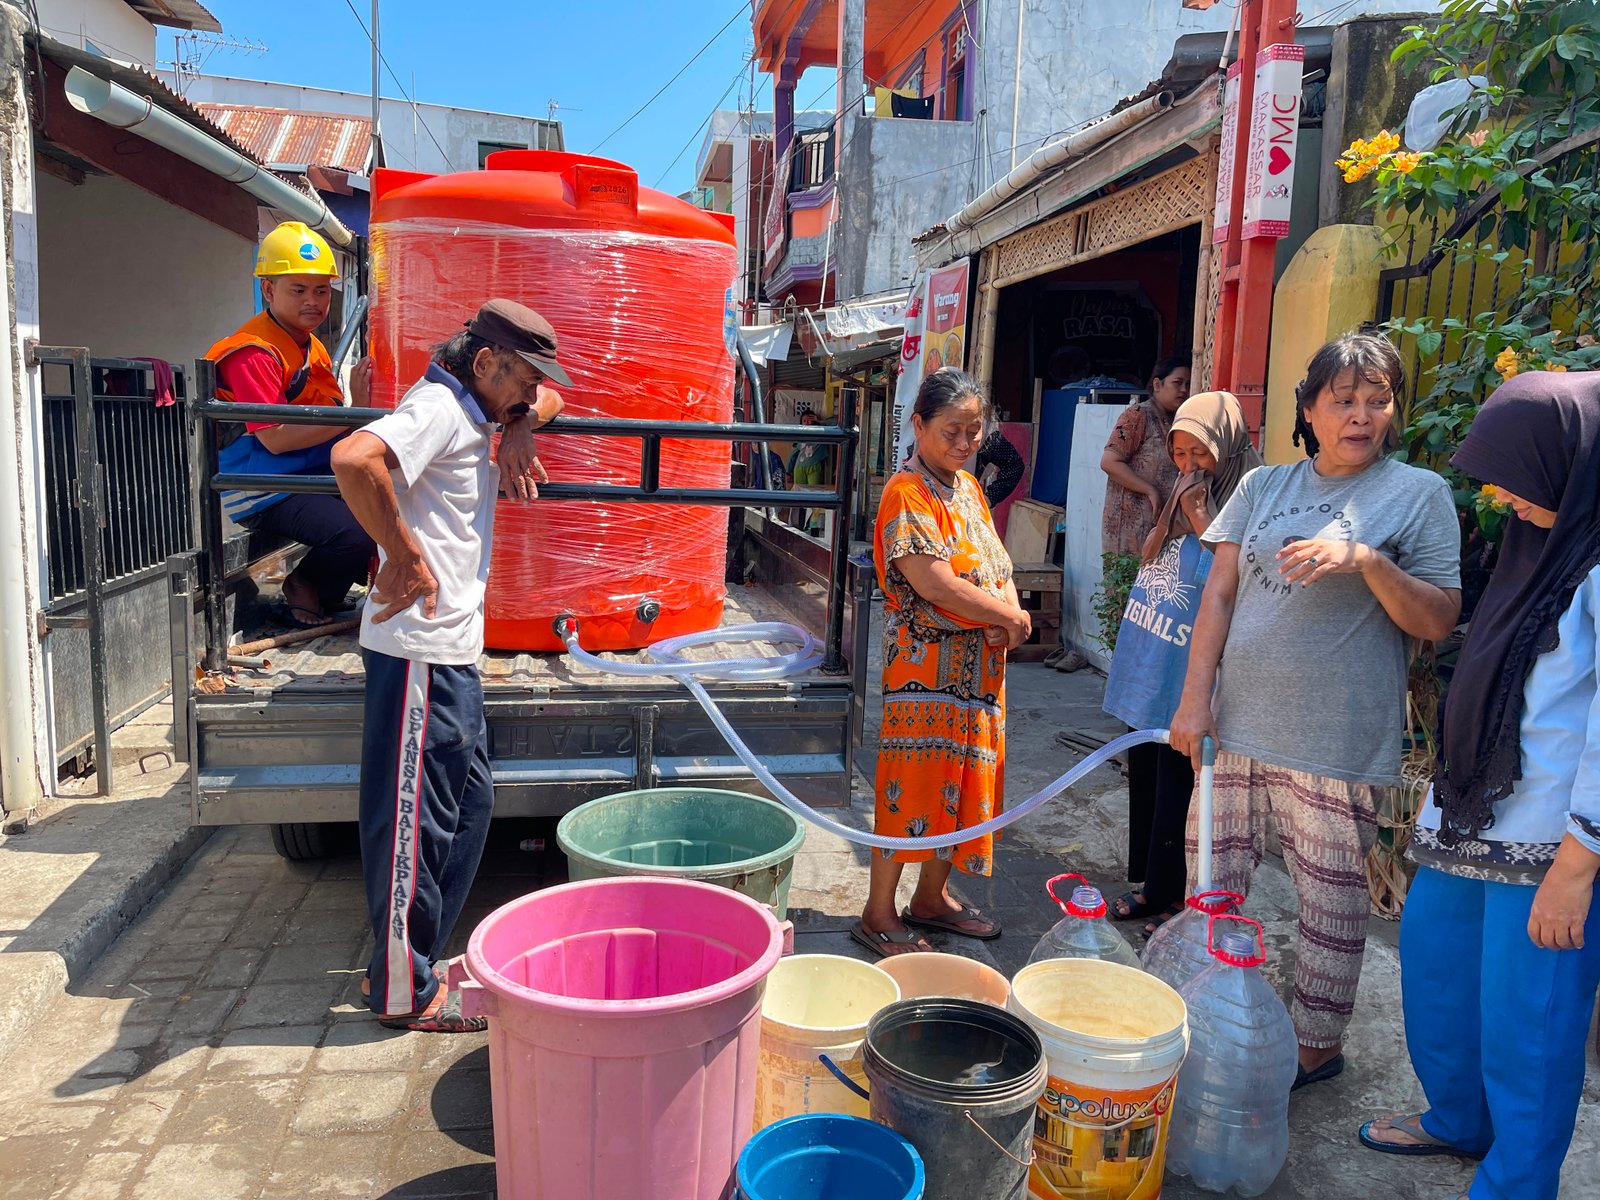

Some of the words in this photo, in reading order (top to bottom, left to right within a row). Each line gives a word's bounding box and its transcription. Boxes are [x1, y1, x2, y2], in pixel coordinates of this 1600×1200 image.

[1217, 106, 1232, 203] MAKASSAR
[1252, 91, 1269, 198] MAKASSAR
[934, 292, 960, 307] Warung
[1063, 315, 1132, 339] RASA
[1246, 551, 1293, 595] DENIM
[1123, 598, 1192, 647] IGINALS
[400, 708, 424, 794] SPANSA
[392, 799, 414, 940] BALIKPAPAN
[1042, 1086, 1149, 1120] epolux
